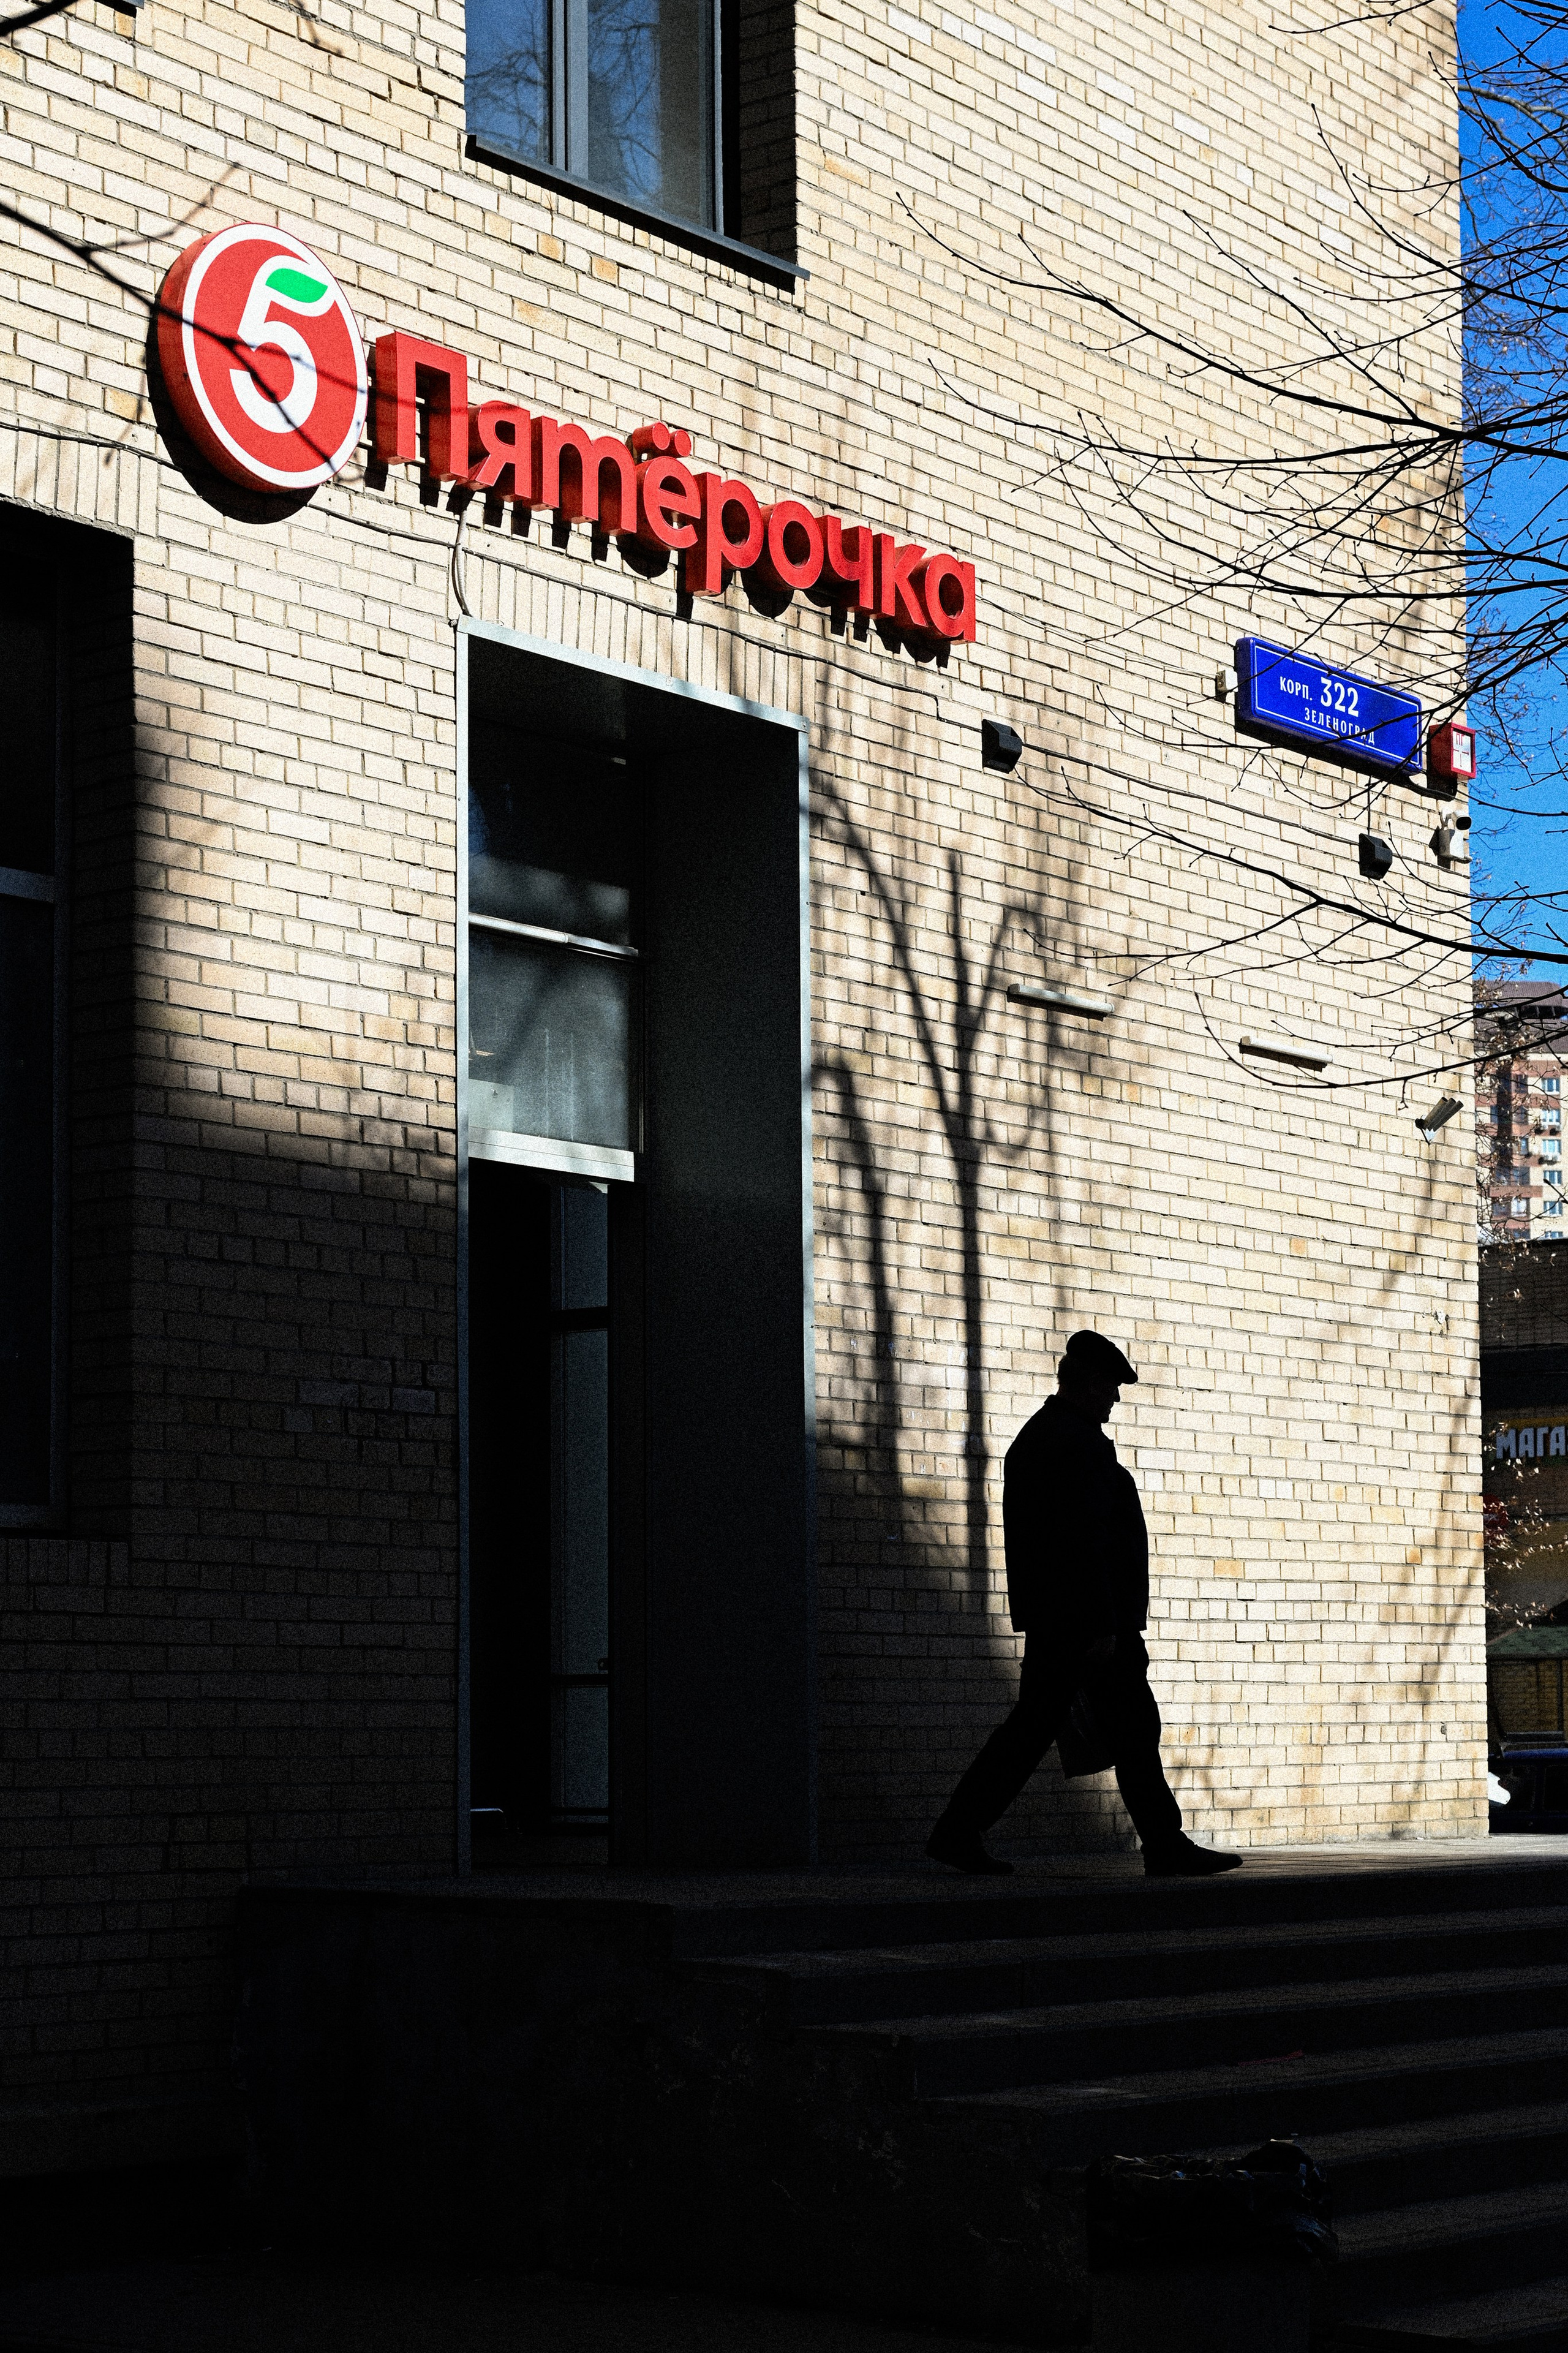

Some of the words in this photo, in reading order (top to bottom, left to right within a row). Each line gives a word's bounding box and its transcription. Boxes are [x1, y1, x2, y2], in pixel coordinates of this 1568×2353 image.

[230, 255, 336, 434] 5
[377, 331, 976, 645] Пятёрочка
[1280, 676, 1313, 701] КОРП.
[1320, 676, 1359, 718] 322
[1304, 707, 1376, 746] ЗЕЛЕНОГРАД
[1496, 1425, 1568, 1459] МАГА
